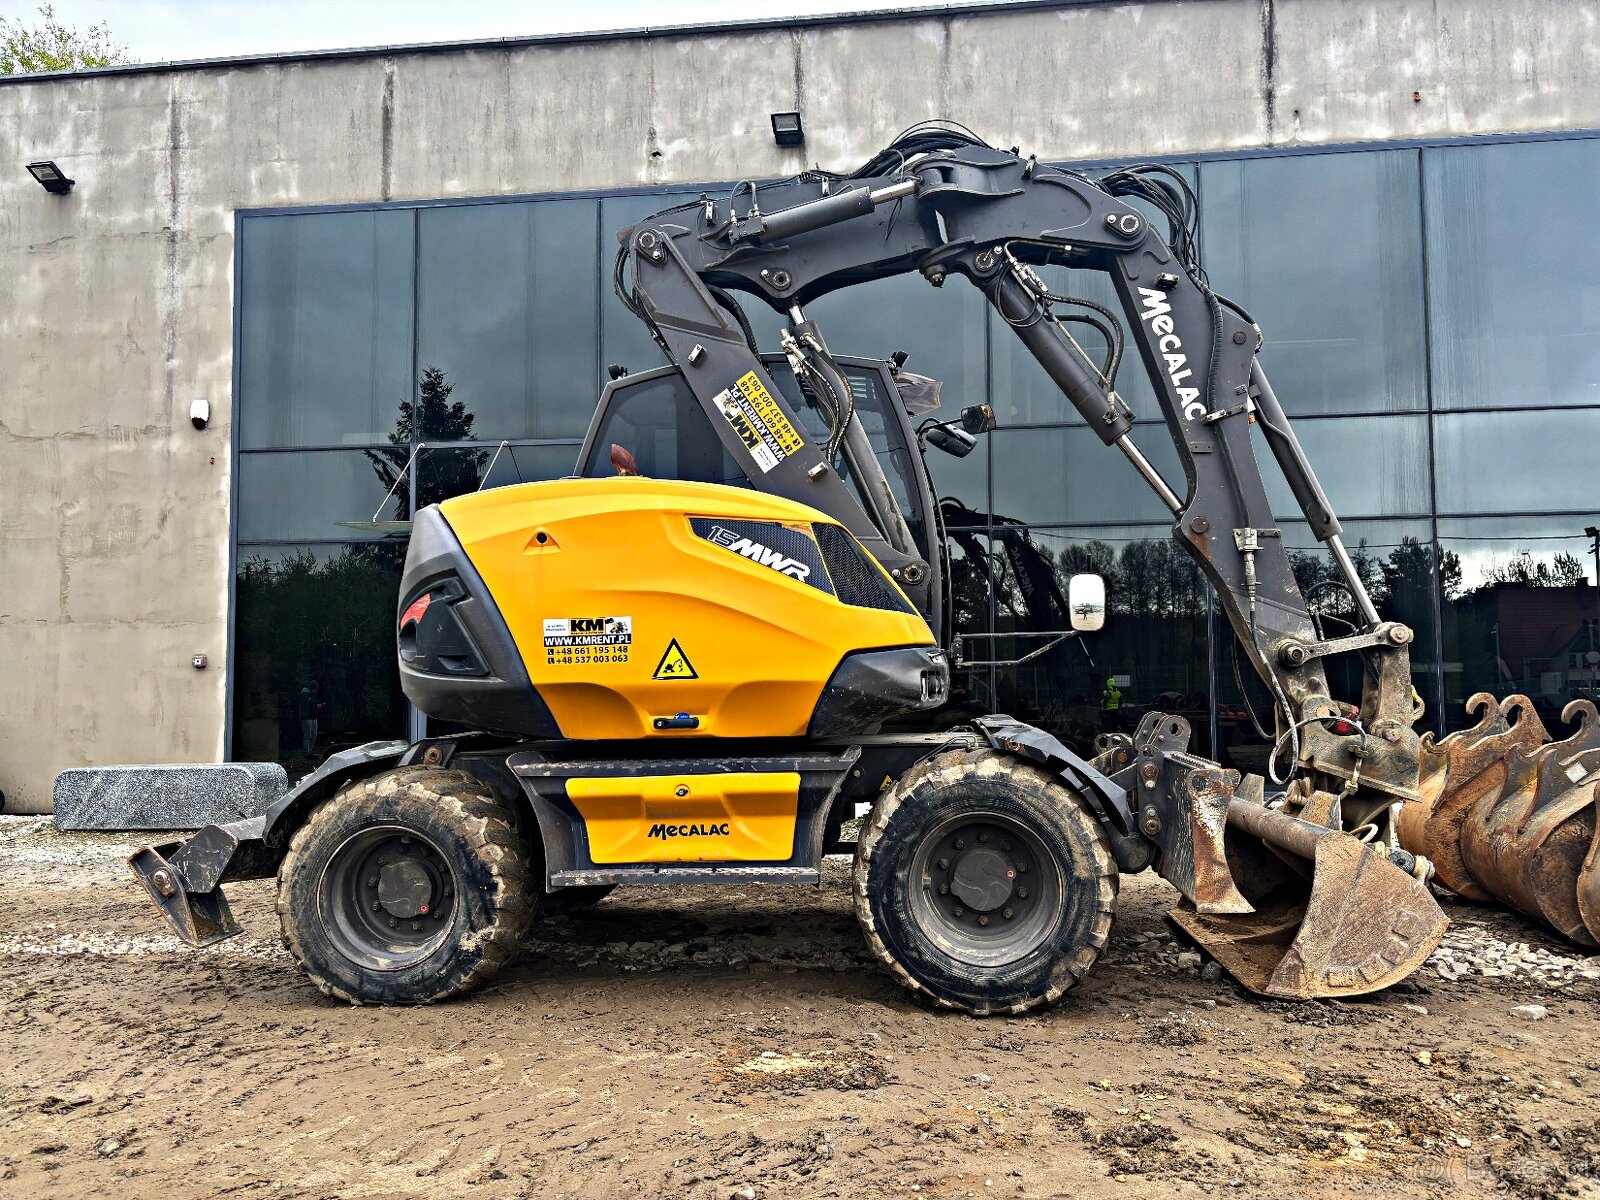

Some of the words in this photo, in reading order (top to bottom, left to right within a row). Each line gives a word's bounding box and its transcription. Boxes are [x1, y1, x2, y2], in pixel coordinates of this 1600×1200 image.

[740, 380, 754, 397] 148
[747, 375, 761, 392] 063
[751, 397, 765, 413] 195
[758, 392, 773, 408] 003
[730, 382, 787, 462] WWW.KMRENT.PL
[763, 413, 777, 429] 661
[769, 408, 785, 424] 537
[730, 413, 760, 450] KM
[571, 619, 603, 631] KM
[545, 635, 630, 646] WWW.KMRENT.PL
[556, 656, 572, 664] +48
